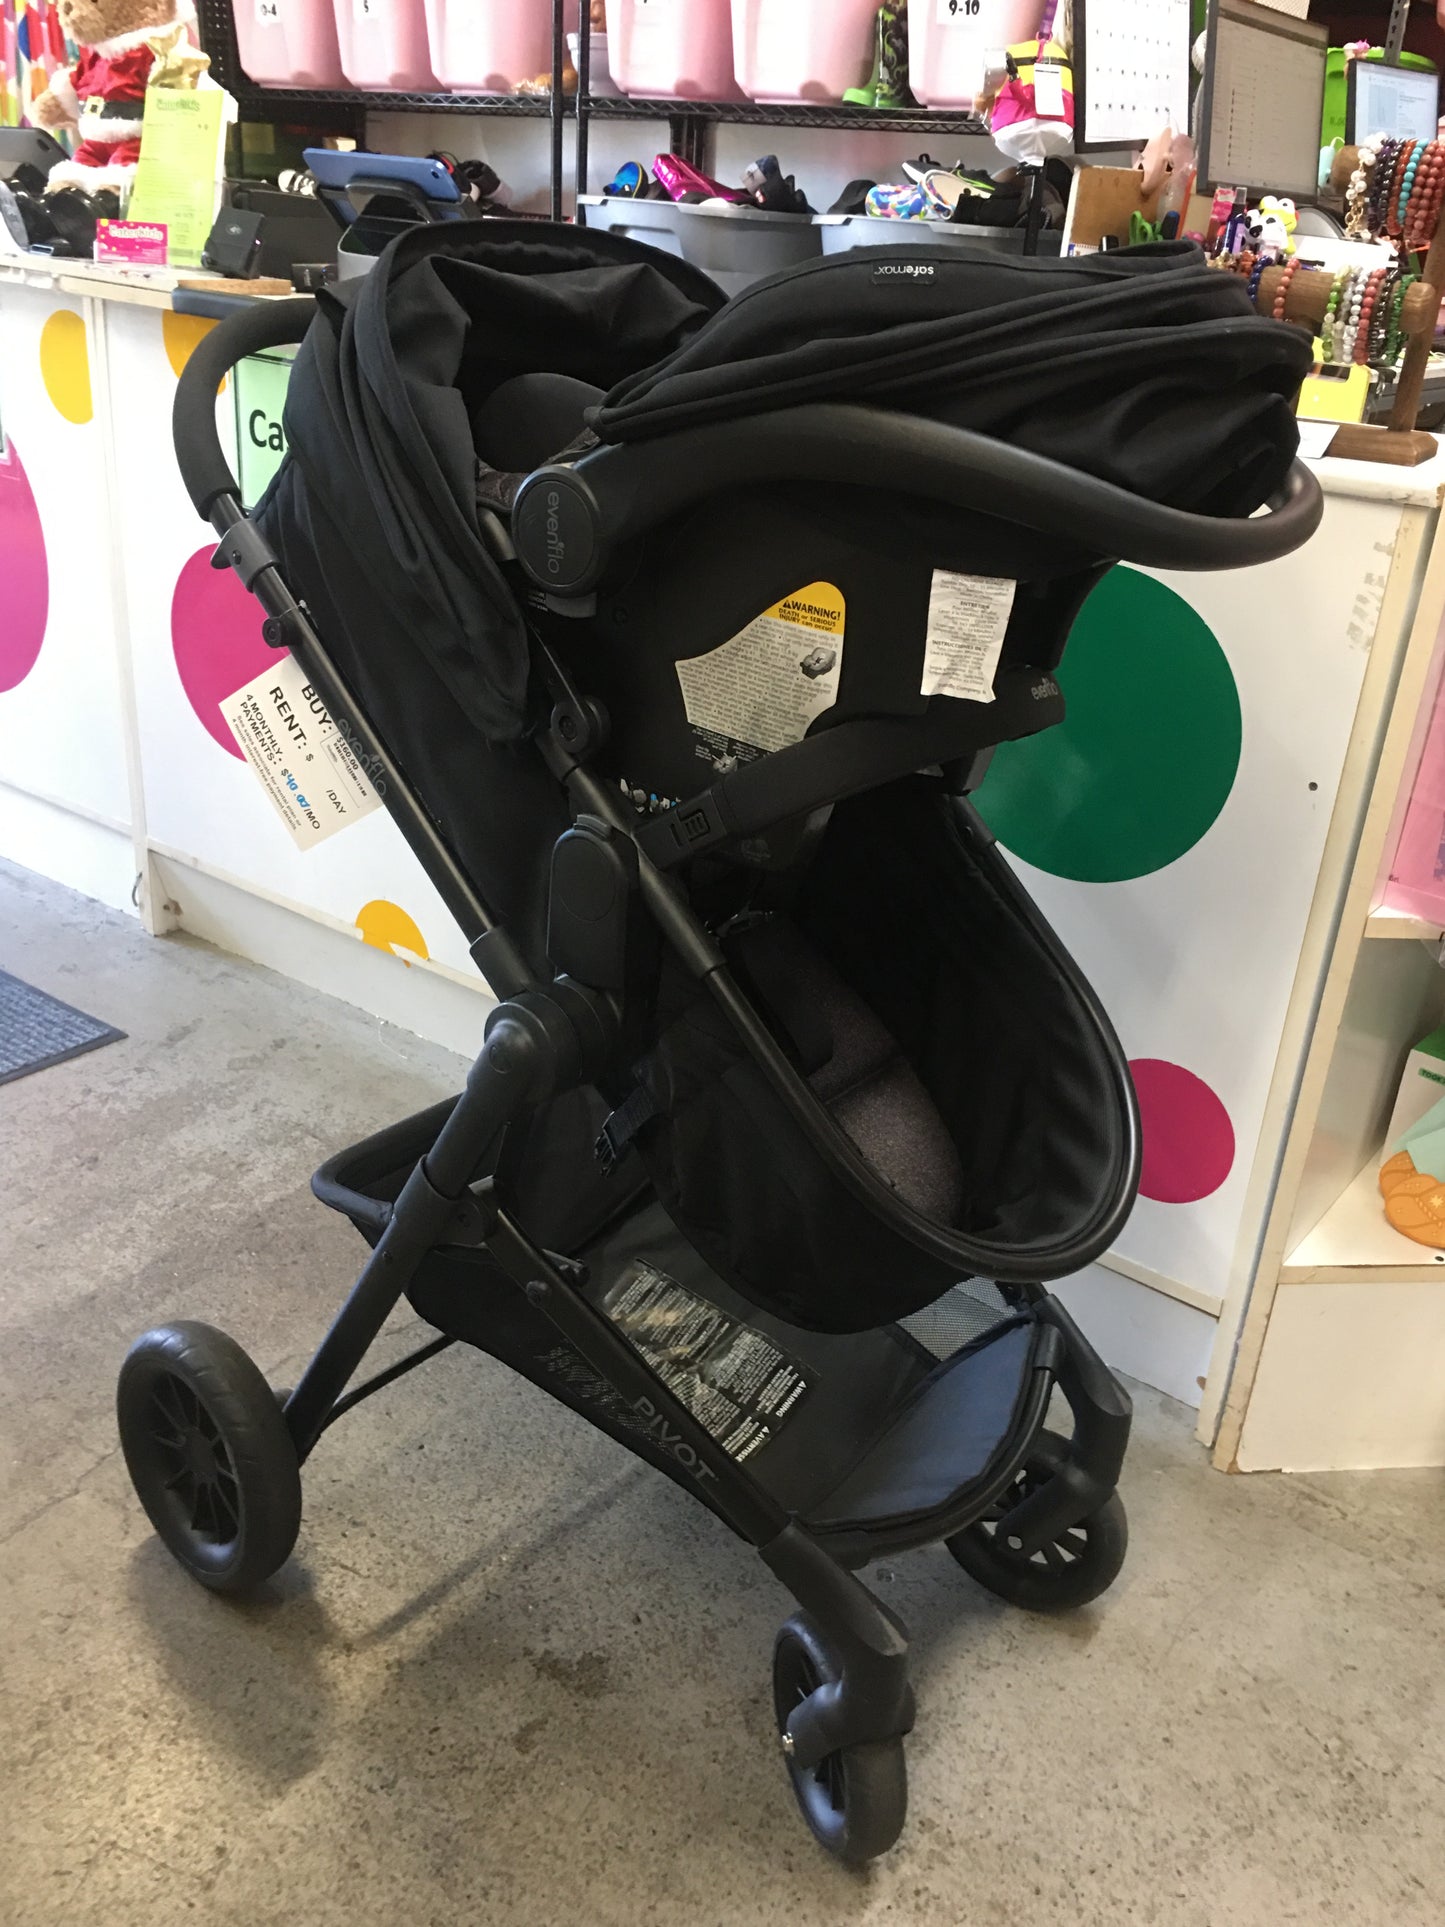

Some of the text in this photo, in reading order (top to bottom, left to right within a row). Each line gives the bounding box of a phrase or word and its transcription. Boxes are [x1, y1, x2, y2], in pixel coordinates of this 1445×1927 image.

[949, 0, 980, 16] 9-10
[878, 265, 934, 277] safemax
[249, 408, 289, 452] Ca
[547, 492, 565, 574] evenflo
[779, 608, 799, 617] DEATH
[810, 616, 835, 627] SERIOUS
[779, 614, 800, 622] INJURY
[790, 600, 841, 621] WARNING!
[246, 694, 283, 754] 4 MONTHLY
[302, 685, 336, 734] BUY:
[235, 724, 246, 743] month
[266, 783, 284, 809] payment
[236, 715, 246, 728] See
[244, 729, 254, 745] sales
[253, 747, 271, 776] associate
[276, 787, 288, 804] rental
[286, 805, 296, 818] plan
[269, 686, 307, 750] RENT:
[325, 789, 346, 815] /DAY
[338, 718, 387, 797] evenflo
[775, 1384, 804, 1418] WARNING
[633, 1396, 717, 1479] PIVOT
